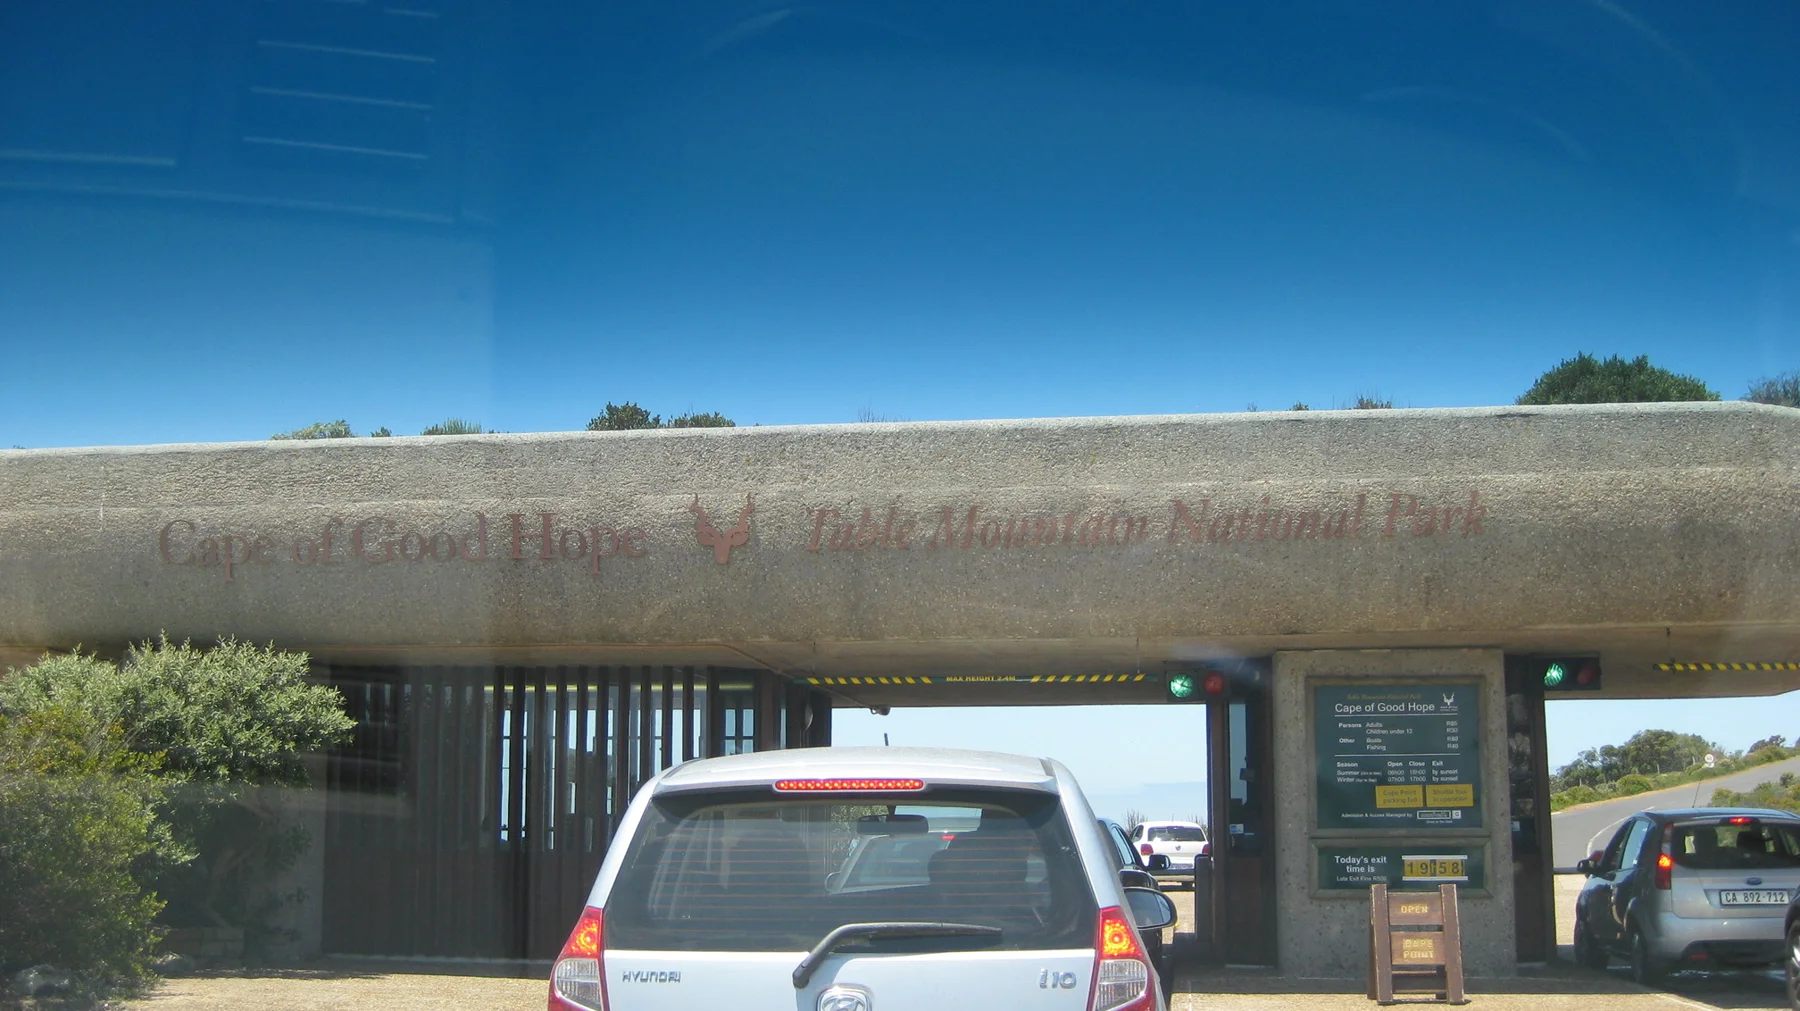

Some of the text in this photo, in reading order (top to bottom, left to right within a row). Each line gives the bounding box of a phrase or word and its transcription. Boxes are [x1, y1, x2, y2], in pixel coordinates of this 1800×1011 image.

[808, 490, 1487, 551] Table Mountain National Park
[159, 509, 649, 583] Cape of Good Hope
[1334, 703, 1362, 714] Cape
[1364, 702, 1376, 712] of
[1377, 702, 1405, 712] Good
[1408, 702, 1435, 713] Hope
[1334, 855, 1387, 865] Today's exit
[1346, 865, 1376, 873] time is
[1725, 892, 1738, 903] CA
[1400, 905, 1429, 914] OPEN
[1403, 950, 1435, 959] POINT
[621, 970, 682, 984] HYUNDAI
[1039, 967, 1078, 990] i10
